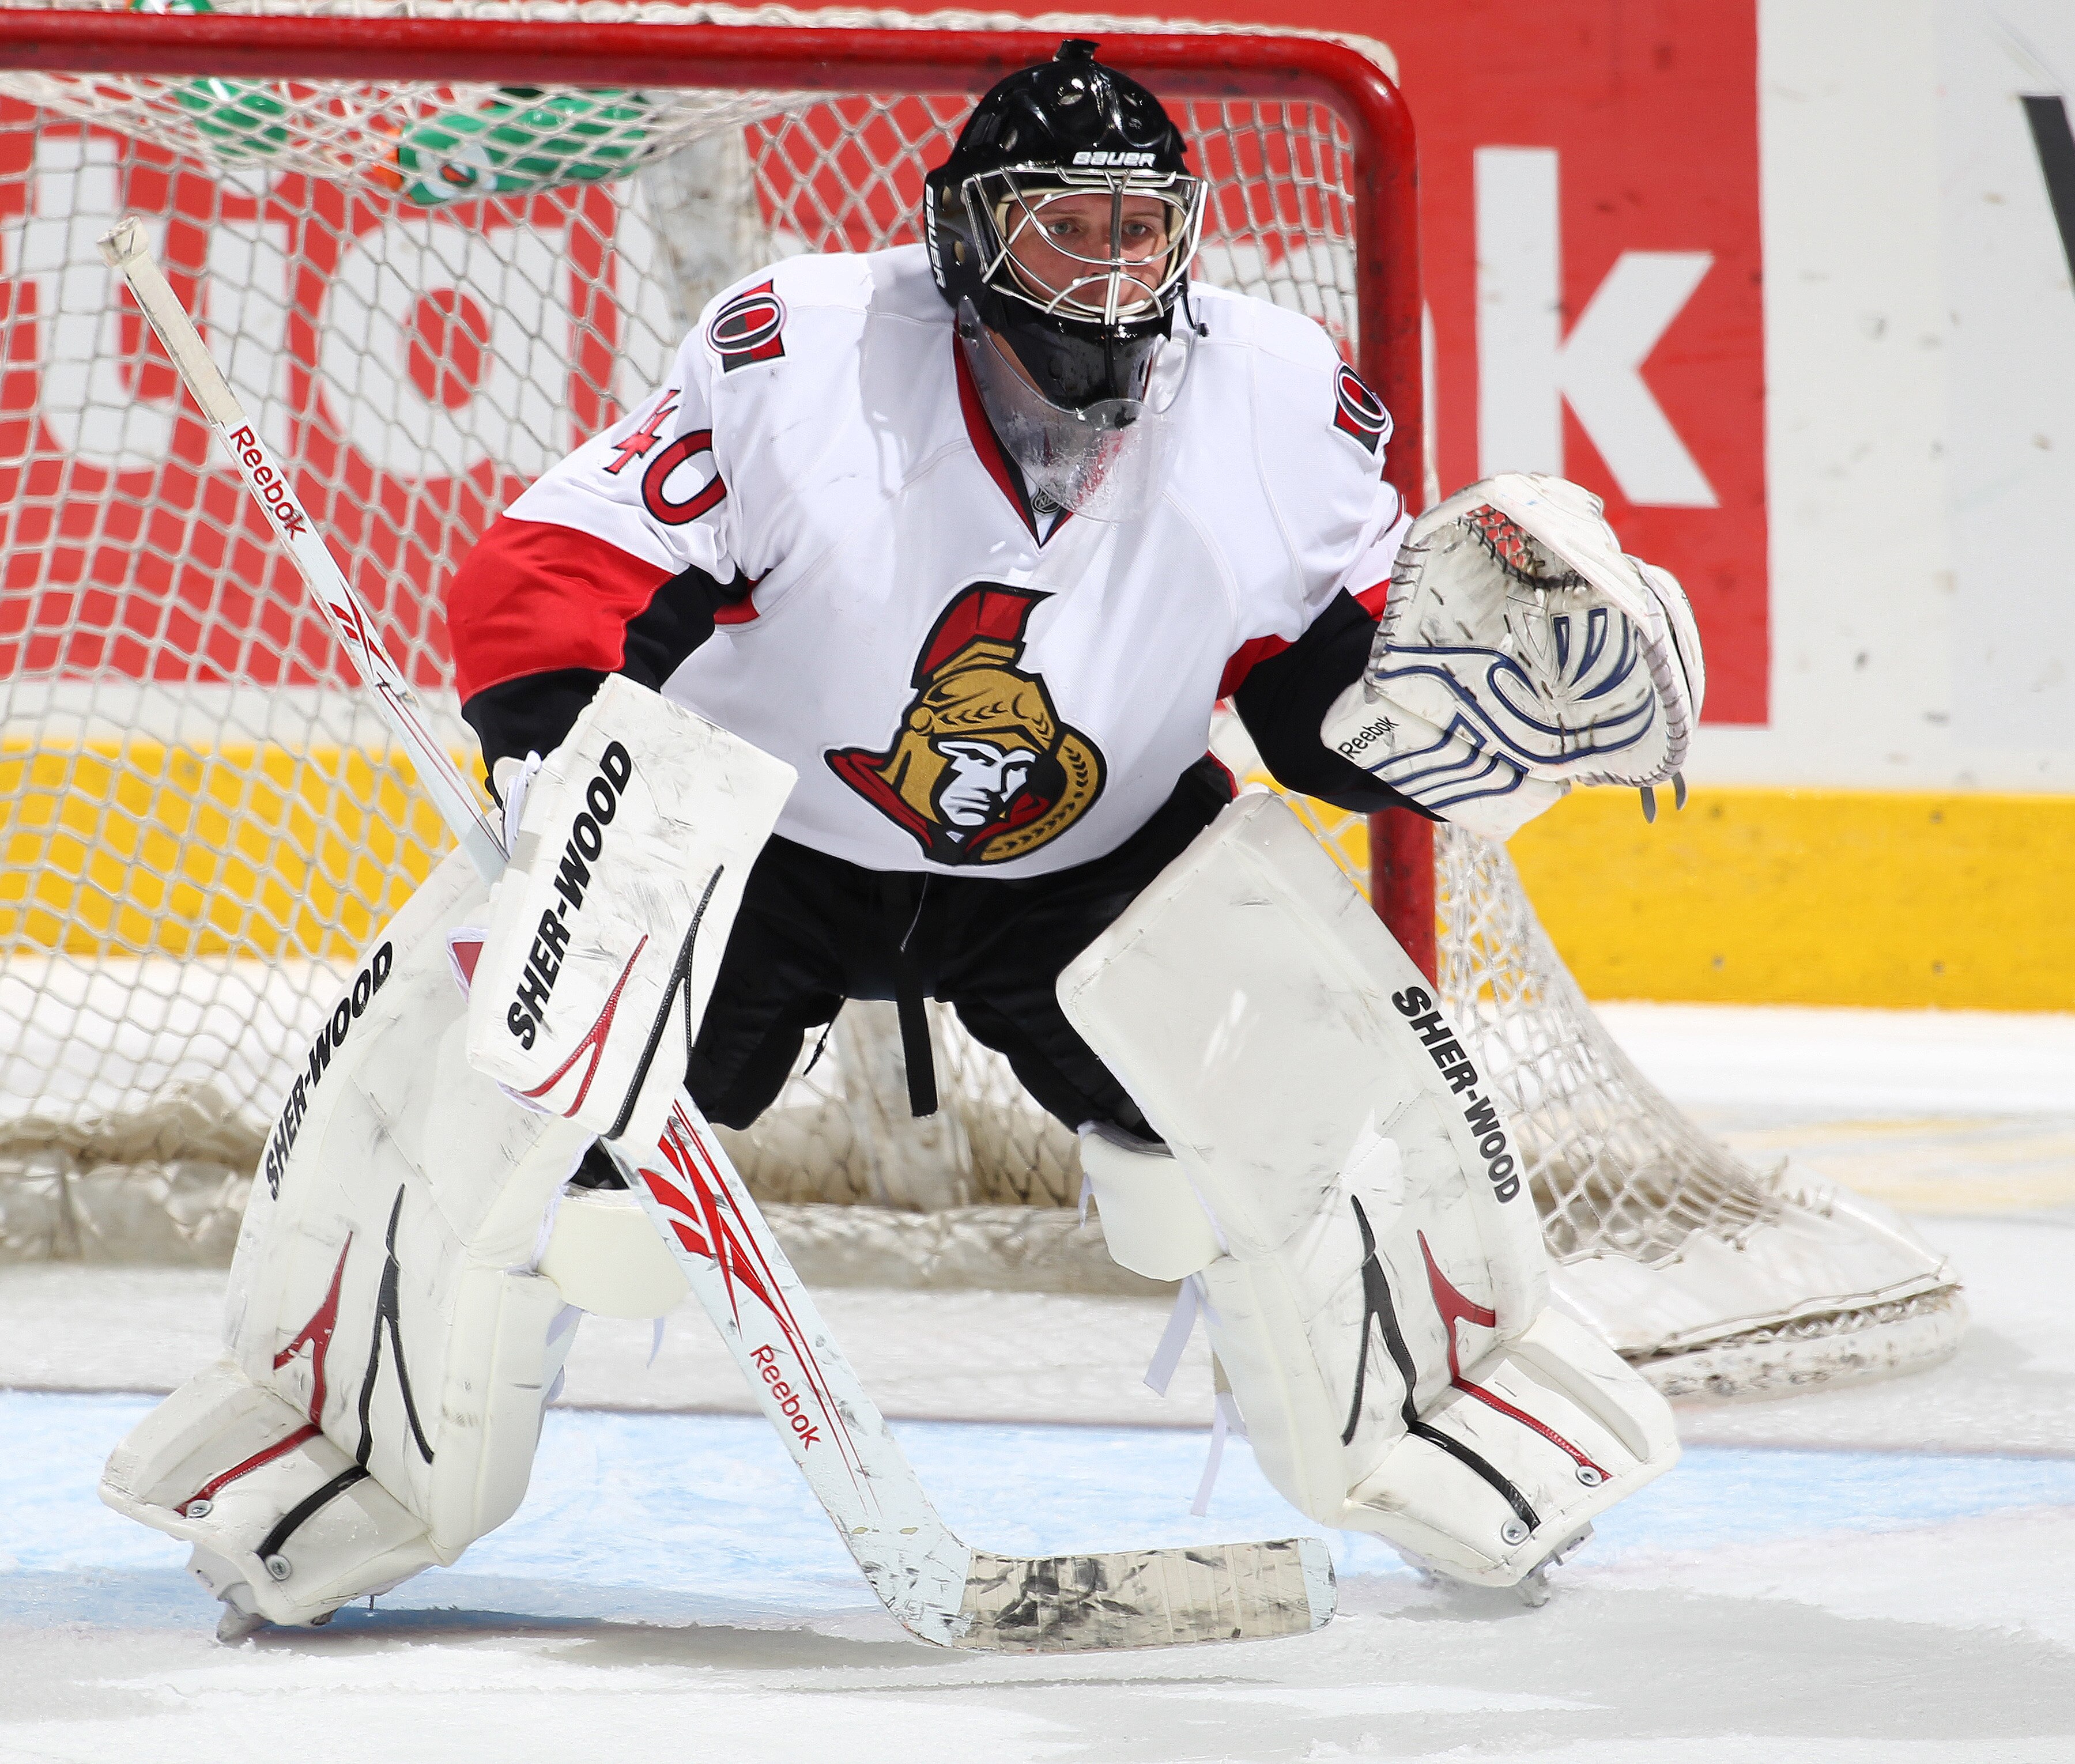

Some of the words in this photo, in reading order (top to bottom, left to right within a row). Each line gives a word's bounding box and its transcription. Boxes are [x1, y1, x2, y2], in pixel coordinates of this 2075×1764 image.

[1072, 152, 1157, 167] BAUER
[925, 183, 946, 289] BAUER
[229, 425, 306, 539] Reebok
[602, 389, 727, 525] 40
[1337, 716, 1399, 760] Reebok
[508, 741, 632, 1051] SHER-WOOD
[265, 940, 393, 1202] SHER-WOOD
[1392, 986, 1520, 1204] SHER-WOOD
[749, 1345, 821, 1451] Reebok
